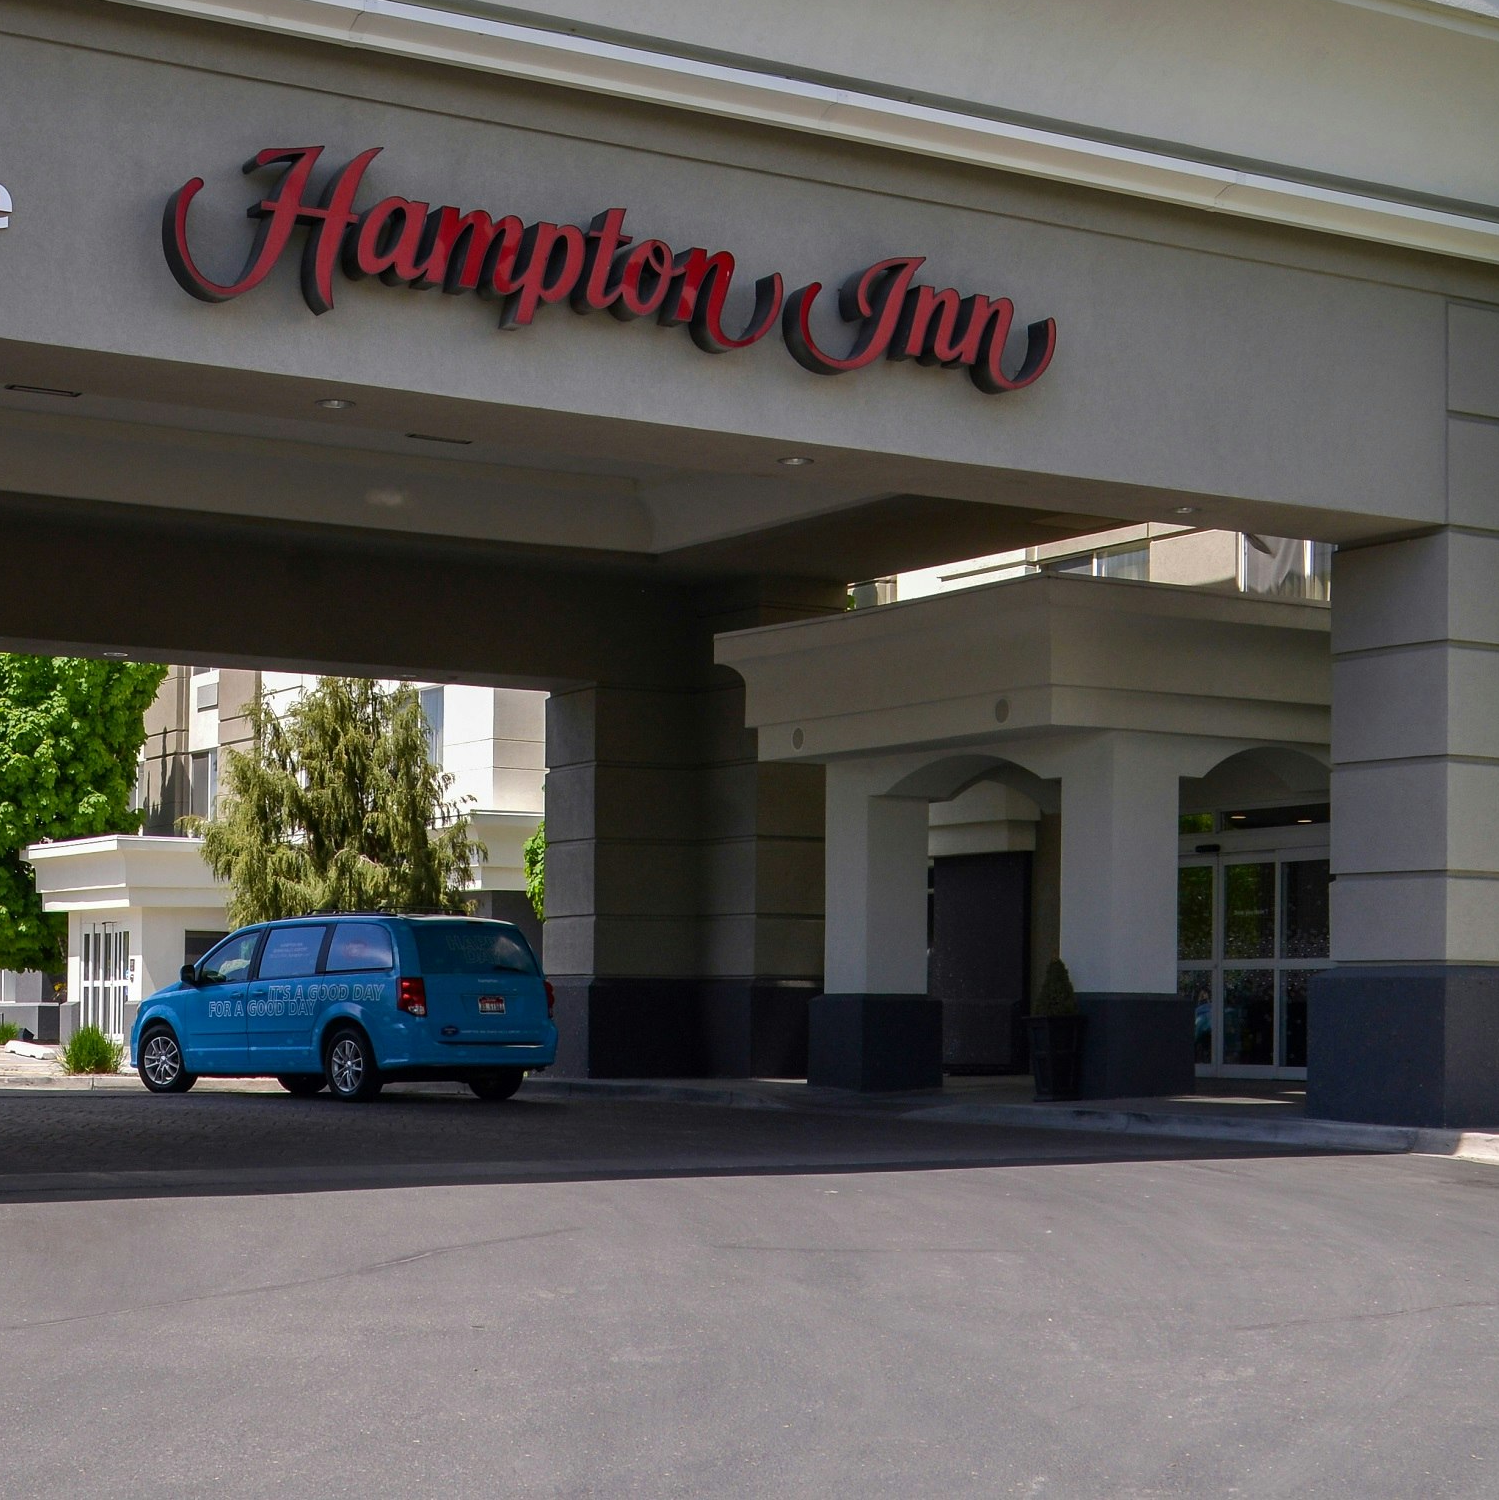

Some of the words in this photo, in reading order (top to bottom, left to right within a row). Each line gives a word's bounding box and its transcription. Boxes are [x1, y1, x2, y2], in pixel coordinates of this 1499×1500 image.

[162, 145, 784, 354] Hampton
[782, 256, 1057, 395] Inn
[267, 985, 291, 1001] IT'S
[293, 985, 304, 1001] A
[307, 984, 350, 1001] GOOD
[352, 983, 386, 1001] DAY
[208, 1001, 232, 1018] FOR
[233, 1001, 244, 1017] A
[246, 1000, 285, 1017] GOOD
[288, 999, 317, 1016] DAY
